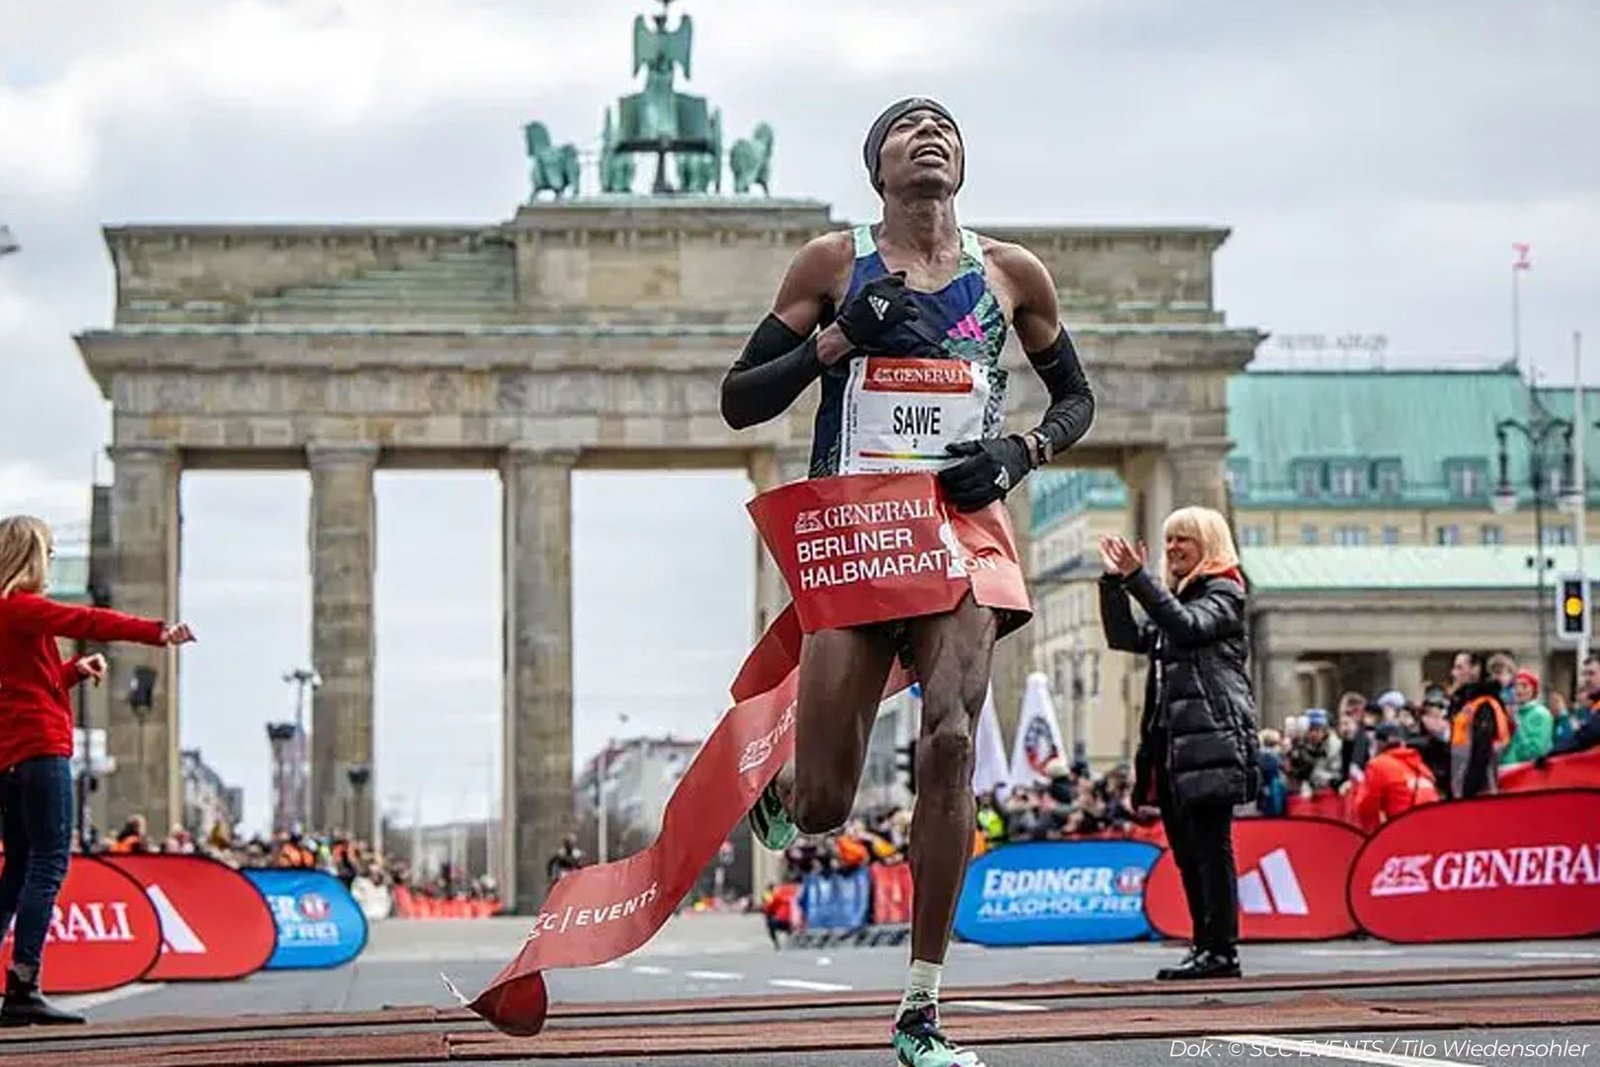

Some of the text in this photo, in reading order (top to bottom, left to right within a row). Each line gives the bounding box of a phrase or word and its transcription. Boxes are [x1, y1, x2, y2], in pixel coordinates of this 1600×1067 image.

[893, 405, 941, 435] SAWE
[823, 497, 936, 528] GENERALI
[797, 527, 914, 563] BERLINER
[800, 549, 997, 590] HALBMARATON
[983, 867, 1113, 898] ERDINGER
[1432, 843, 1600, 890] GENERA
[45, 901, 135, 941] RALI
[576, 882, 658, 926] EVENTS
